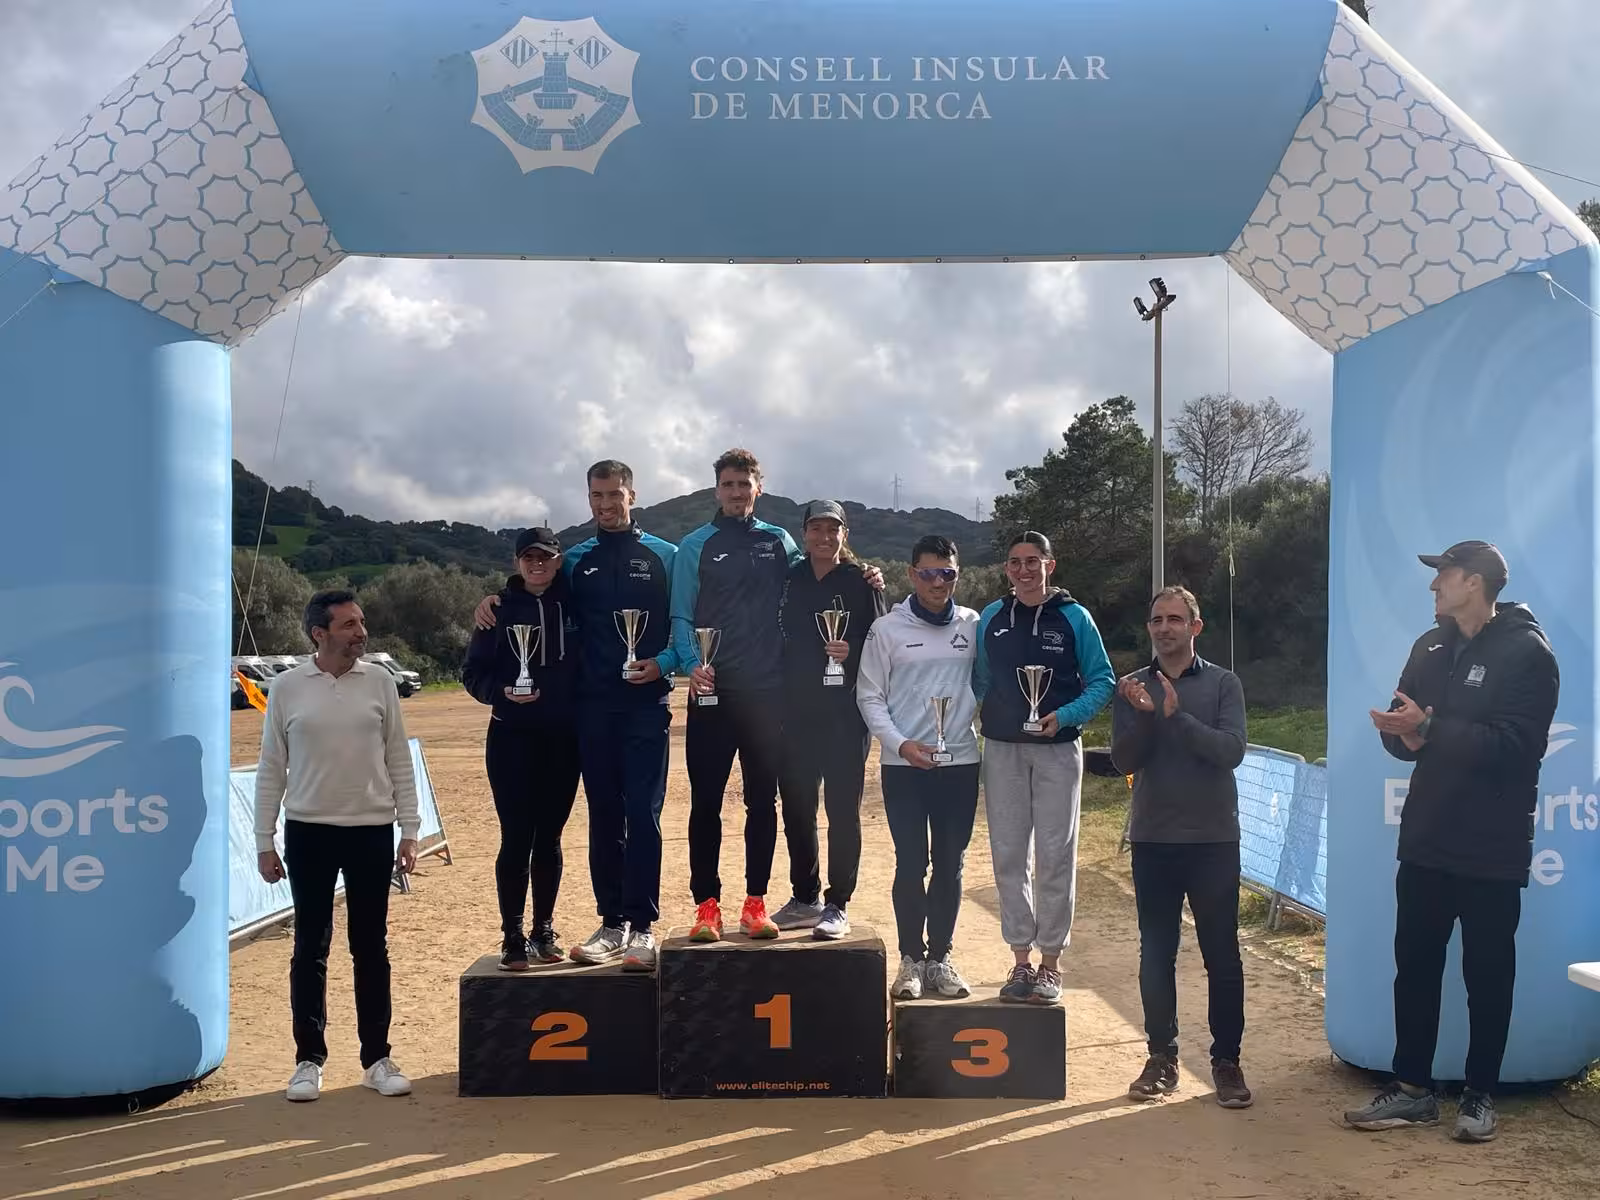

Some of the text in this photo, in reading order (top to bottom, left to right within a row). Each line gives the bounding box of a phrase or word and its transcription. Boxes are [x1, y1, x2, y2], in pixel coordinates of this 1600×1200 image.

[691, 55, 1110, 83] CONSELL INSULAR
[691, 91, 993, 120] DE MENORCA
[6, 845, 105, 893] Me
[529, 1011, 589, 1062] 2
[754, 994, 793, 1050] 1
[951, 1028, 1010, 1078] 3
[715, 1081, 832, 1092] www.elitechip.net
